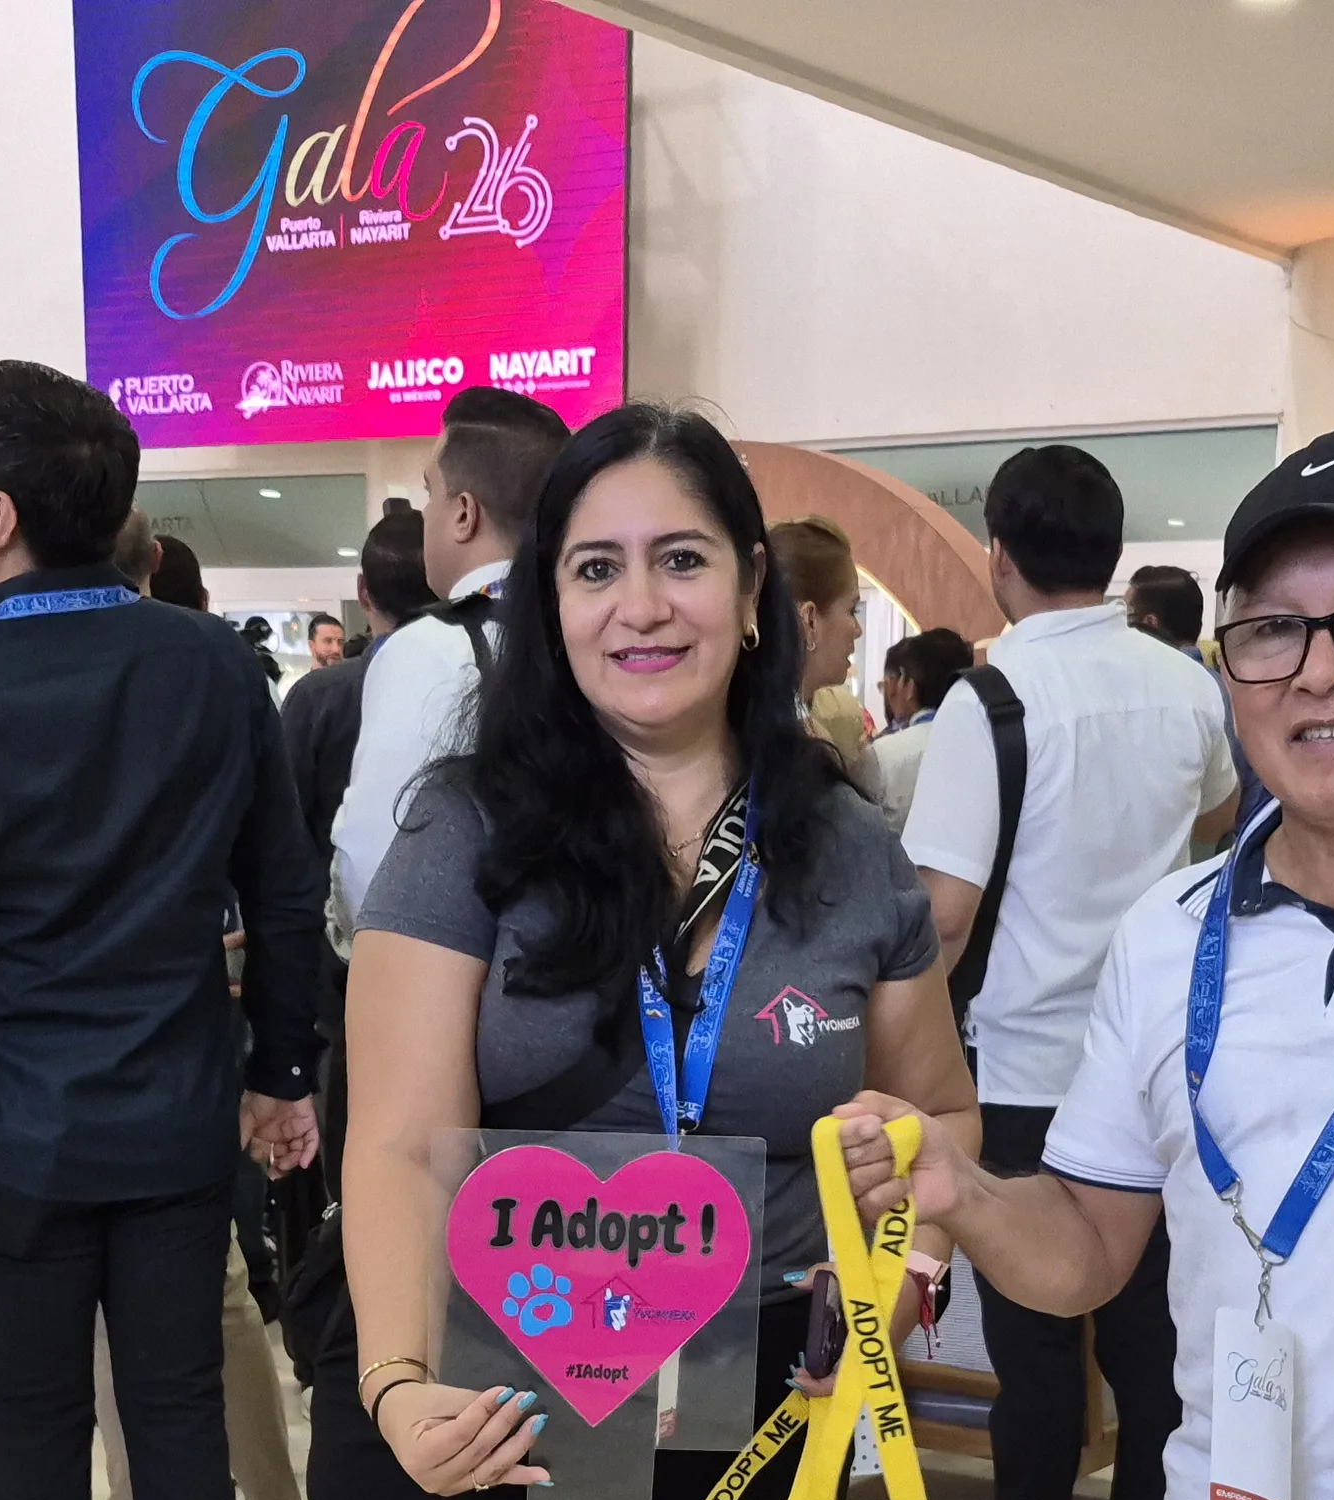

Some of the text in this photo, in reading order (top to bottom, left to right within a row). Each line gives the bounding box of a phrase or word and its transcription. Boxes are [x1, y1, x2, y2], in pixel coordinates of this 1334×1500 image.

[440, 115, 553, 248] 26
[280, 216, 322, 233] Puerto
[359, 208, 403, 225] Riviera
[266, 228, 336, 252] VALLARTA
[350, 222, 411, 245] NAYARIT
[367, 357, 464, 390] JALISCO
[489, 347, 596, 381] NAYARIT
[125, 374, 195, 396] PUERTO
[126, 392, 214, 416] VALLARTA
[489, 1198, 518, 1248] I
[531, 1197, 686, 1269] Adopt
[566, 1364, 629, 1384] #IAdopt
[849, 1299, 906, 1443] ADOPT ME
[763, 1409, 800, 1447] ME
